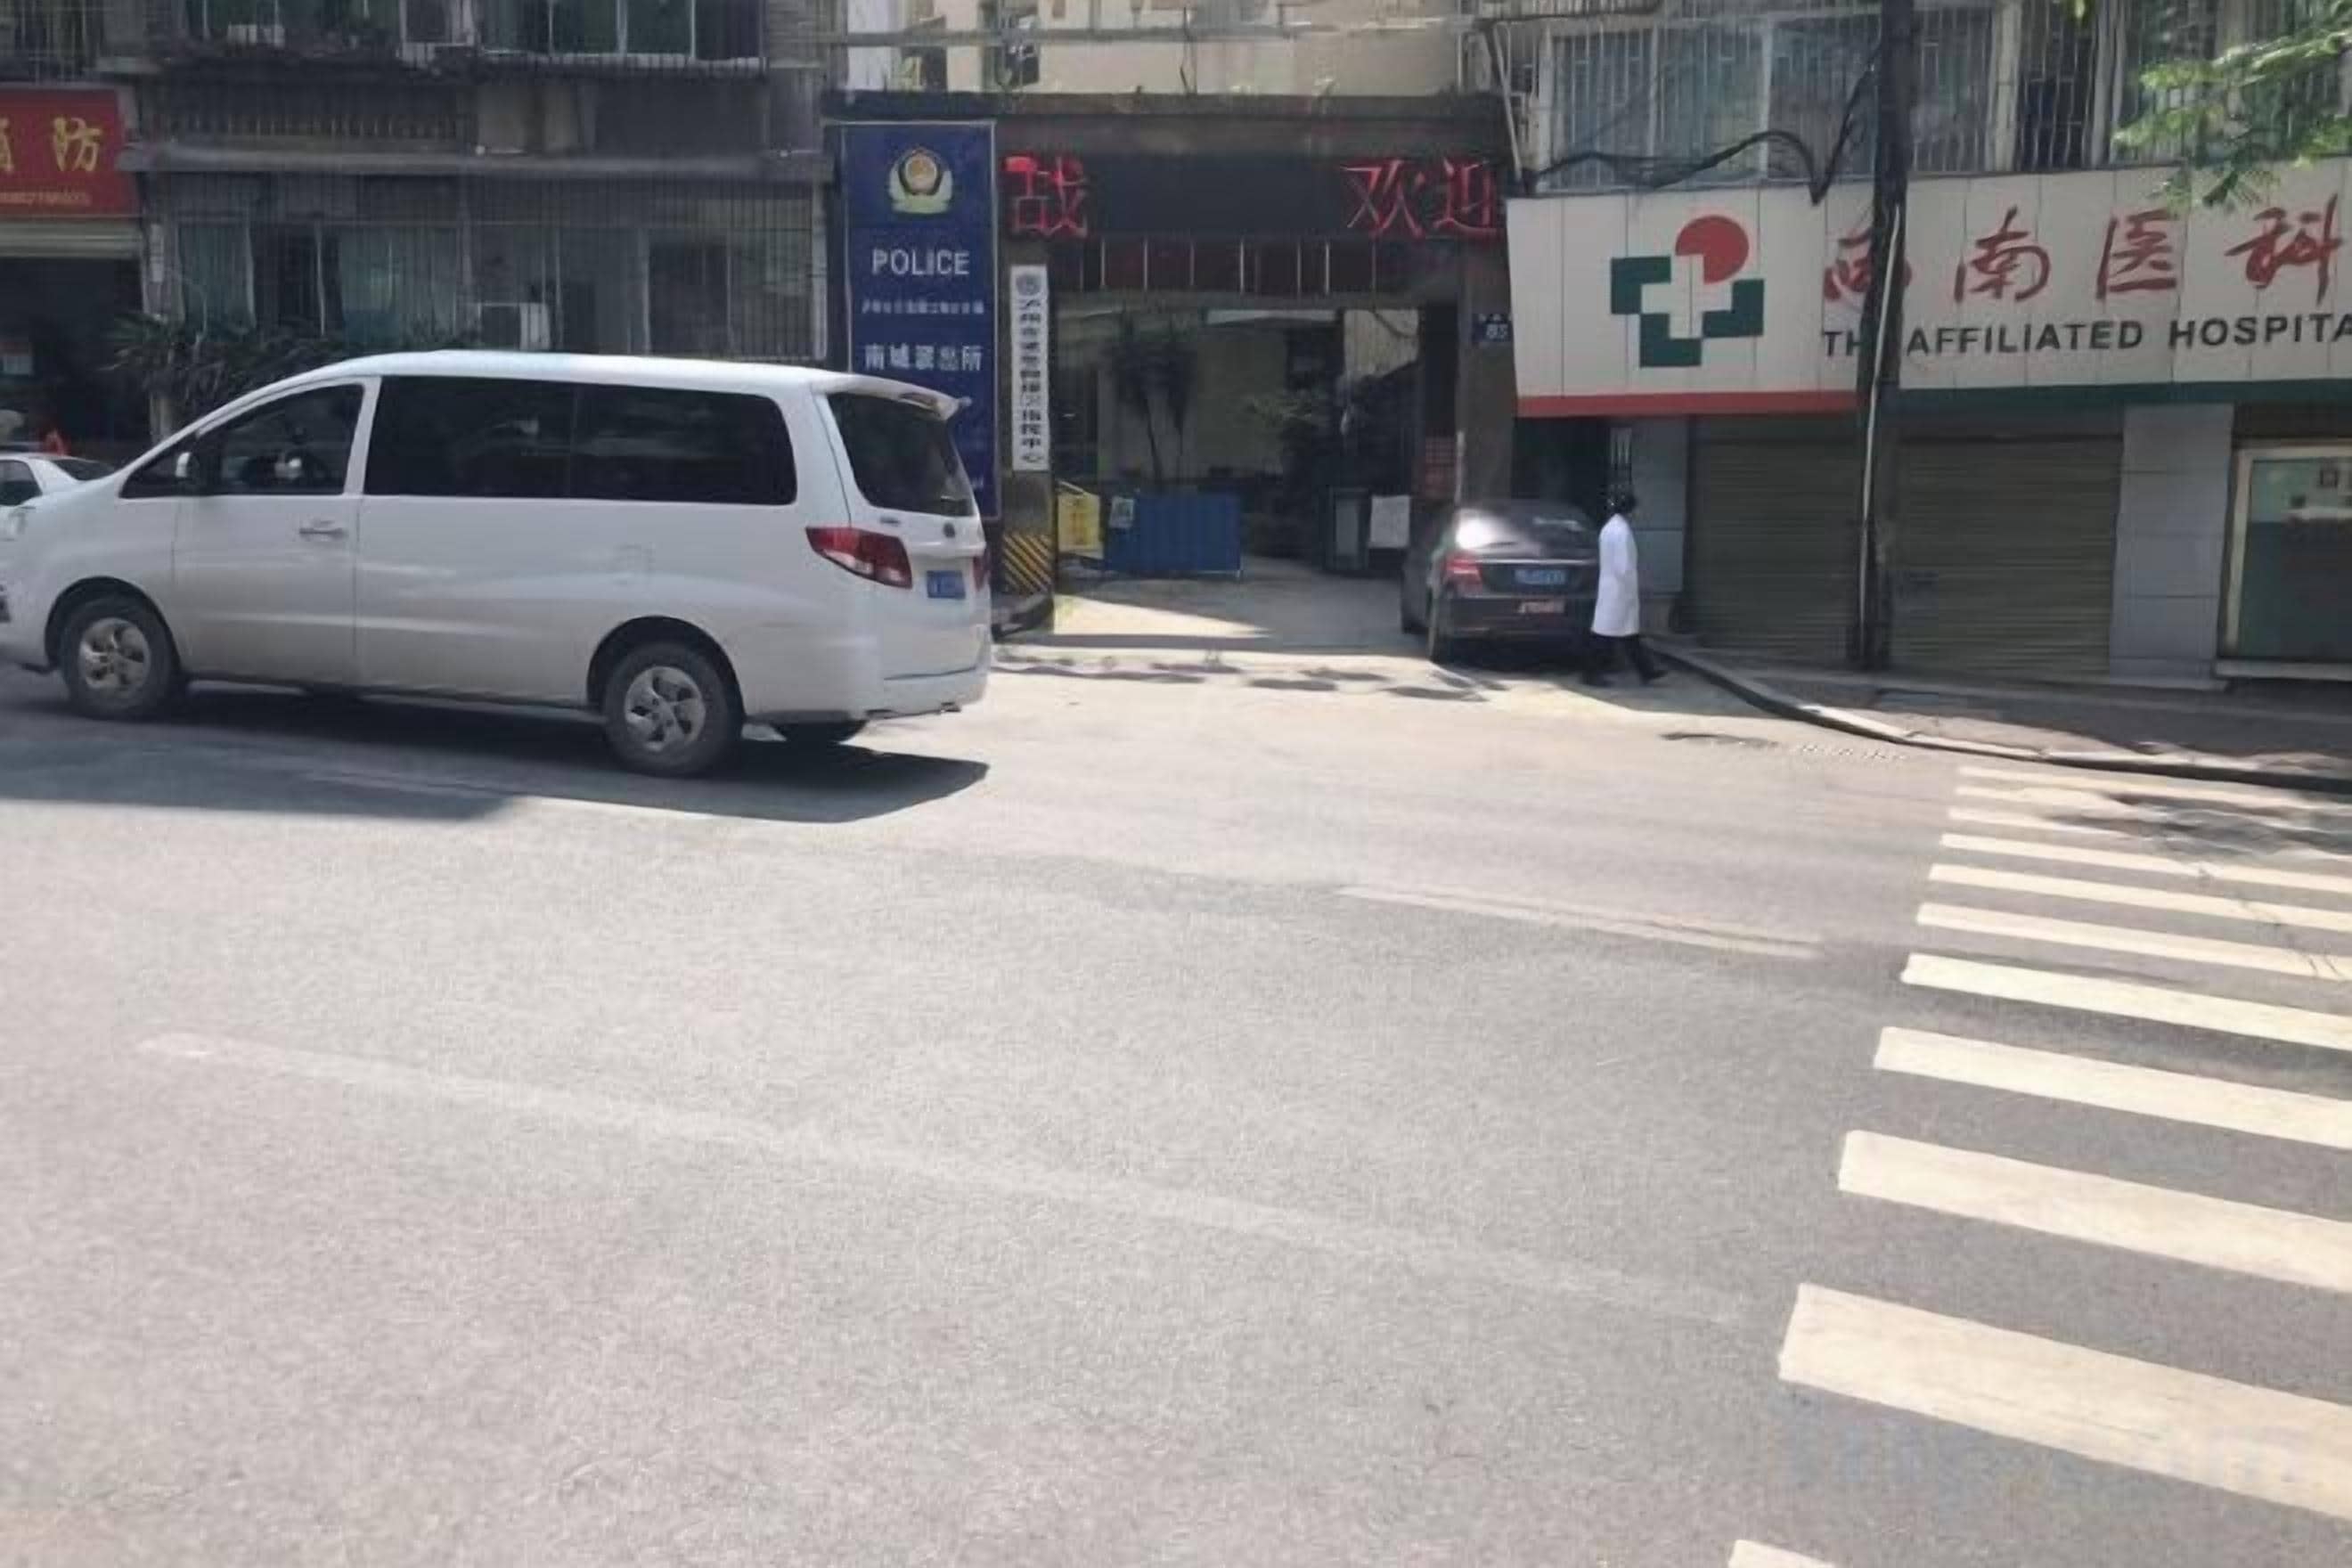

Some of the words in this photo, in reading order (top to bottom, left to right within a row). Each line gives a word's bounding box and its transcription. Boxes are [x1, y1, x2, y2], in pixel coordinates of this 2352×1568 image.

[1341, 157, 1500, 237] 欢迎
[872, 249, 970, 274] POLICE
[1906, 320, 2143, 355] AFFILIATED
